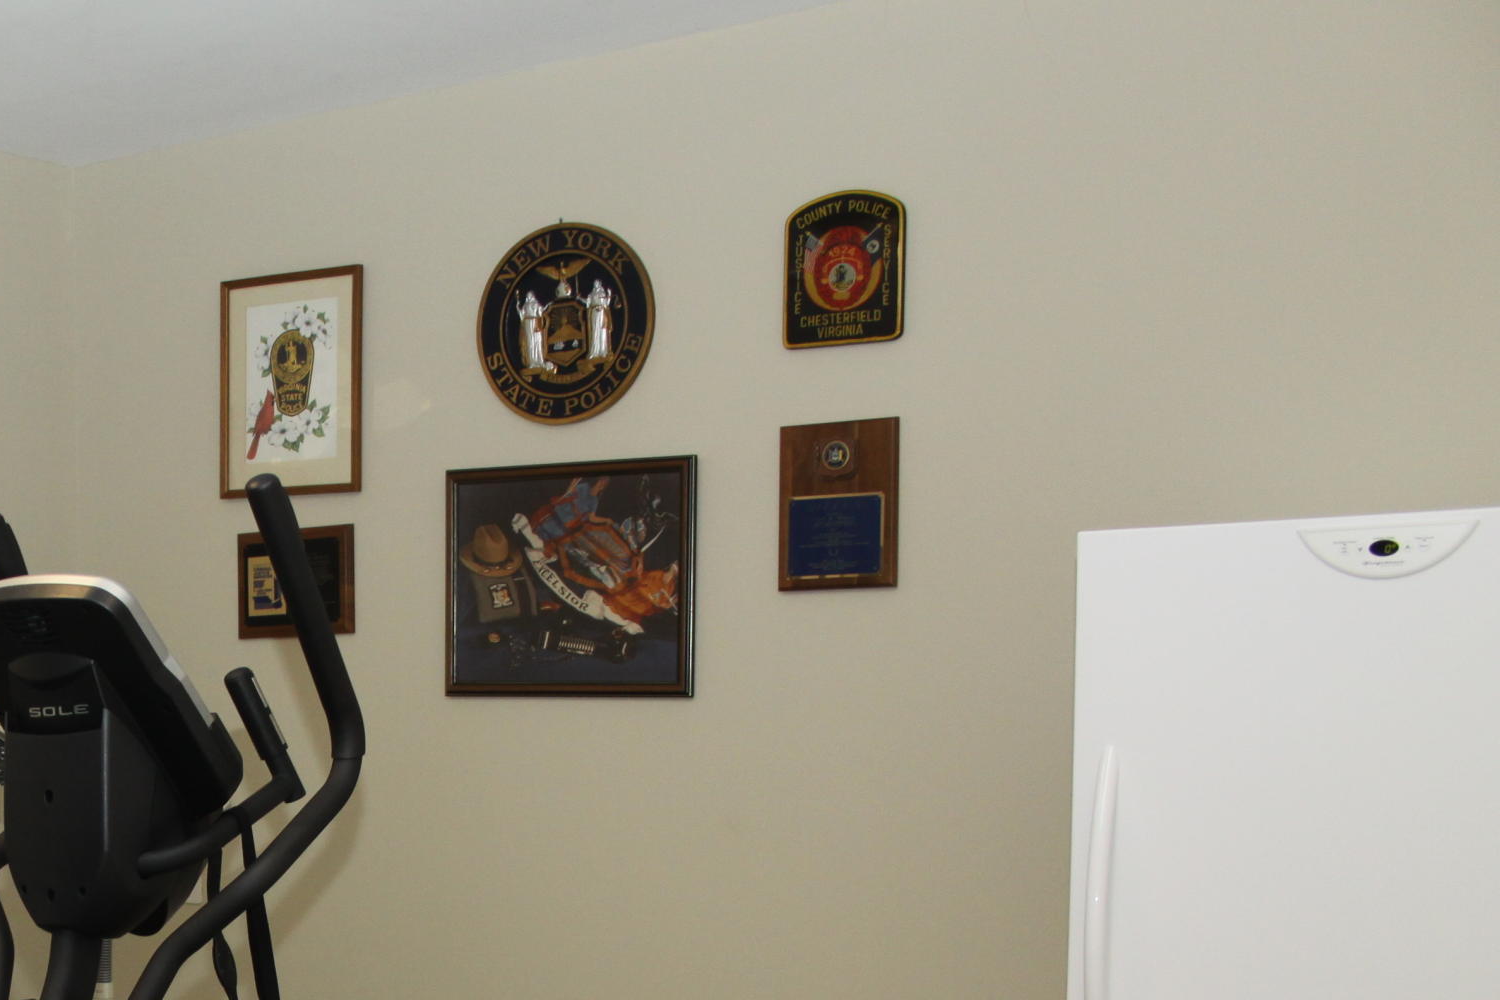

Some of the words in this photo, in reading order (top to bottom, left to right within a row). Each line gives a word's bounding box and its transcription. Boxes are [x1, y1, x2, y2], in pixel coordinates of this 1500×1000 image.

[796, 200, 843, 230] COUNTY
[848, 199, 892, 220] POLICE
[496, 236, 551, 290] NEW
[562, 230, 631, 276] YORK
[794, 234, 803, 315] JUSTICE
[882, 223, 892, 306] SERVICE
[800, 309, 882, 328] CHESTERFIELD
[817, 323, 864, 339] VIRGINIA
[486, 351, 552, 416] STATE
[564, 333, 643, 416] POLICE
[28, 704, 90, 718] SOLE
